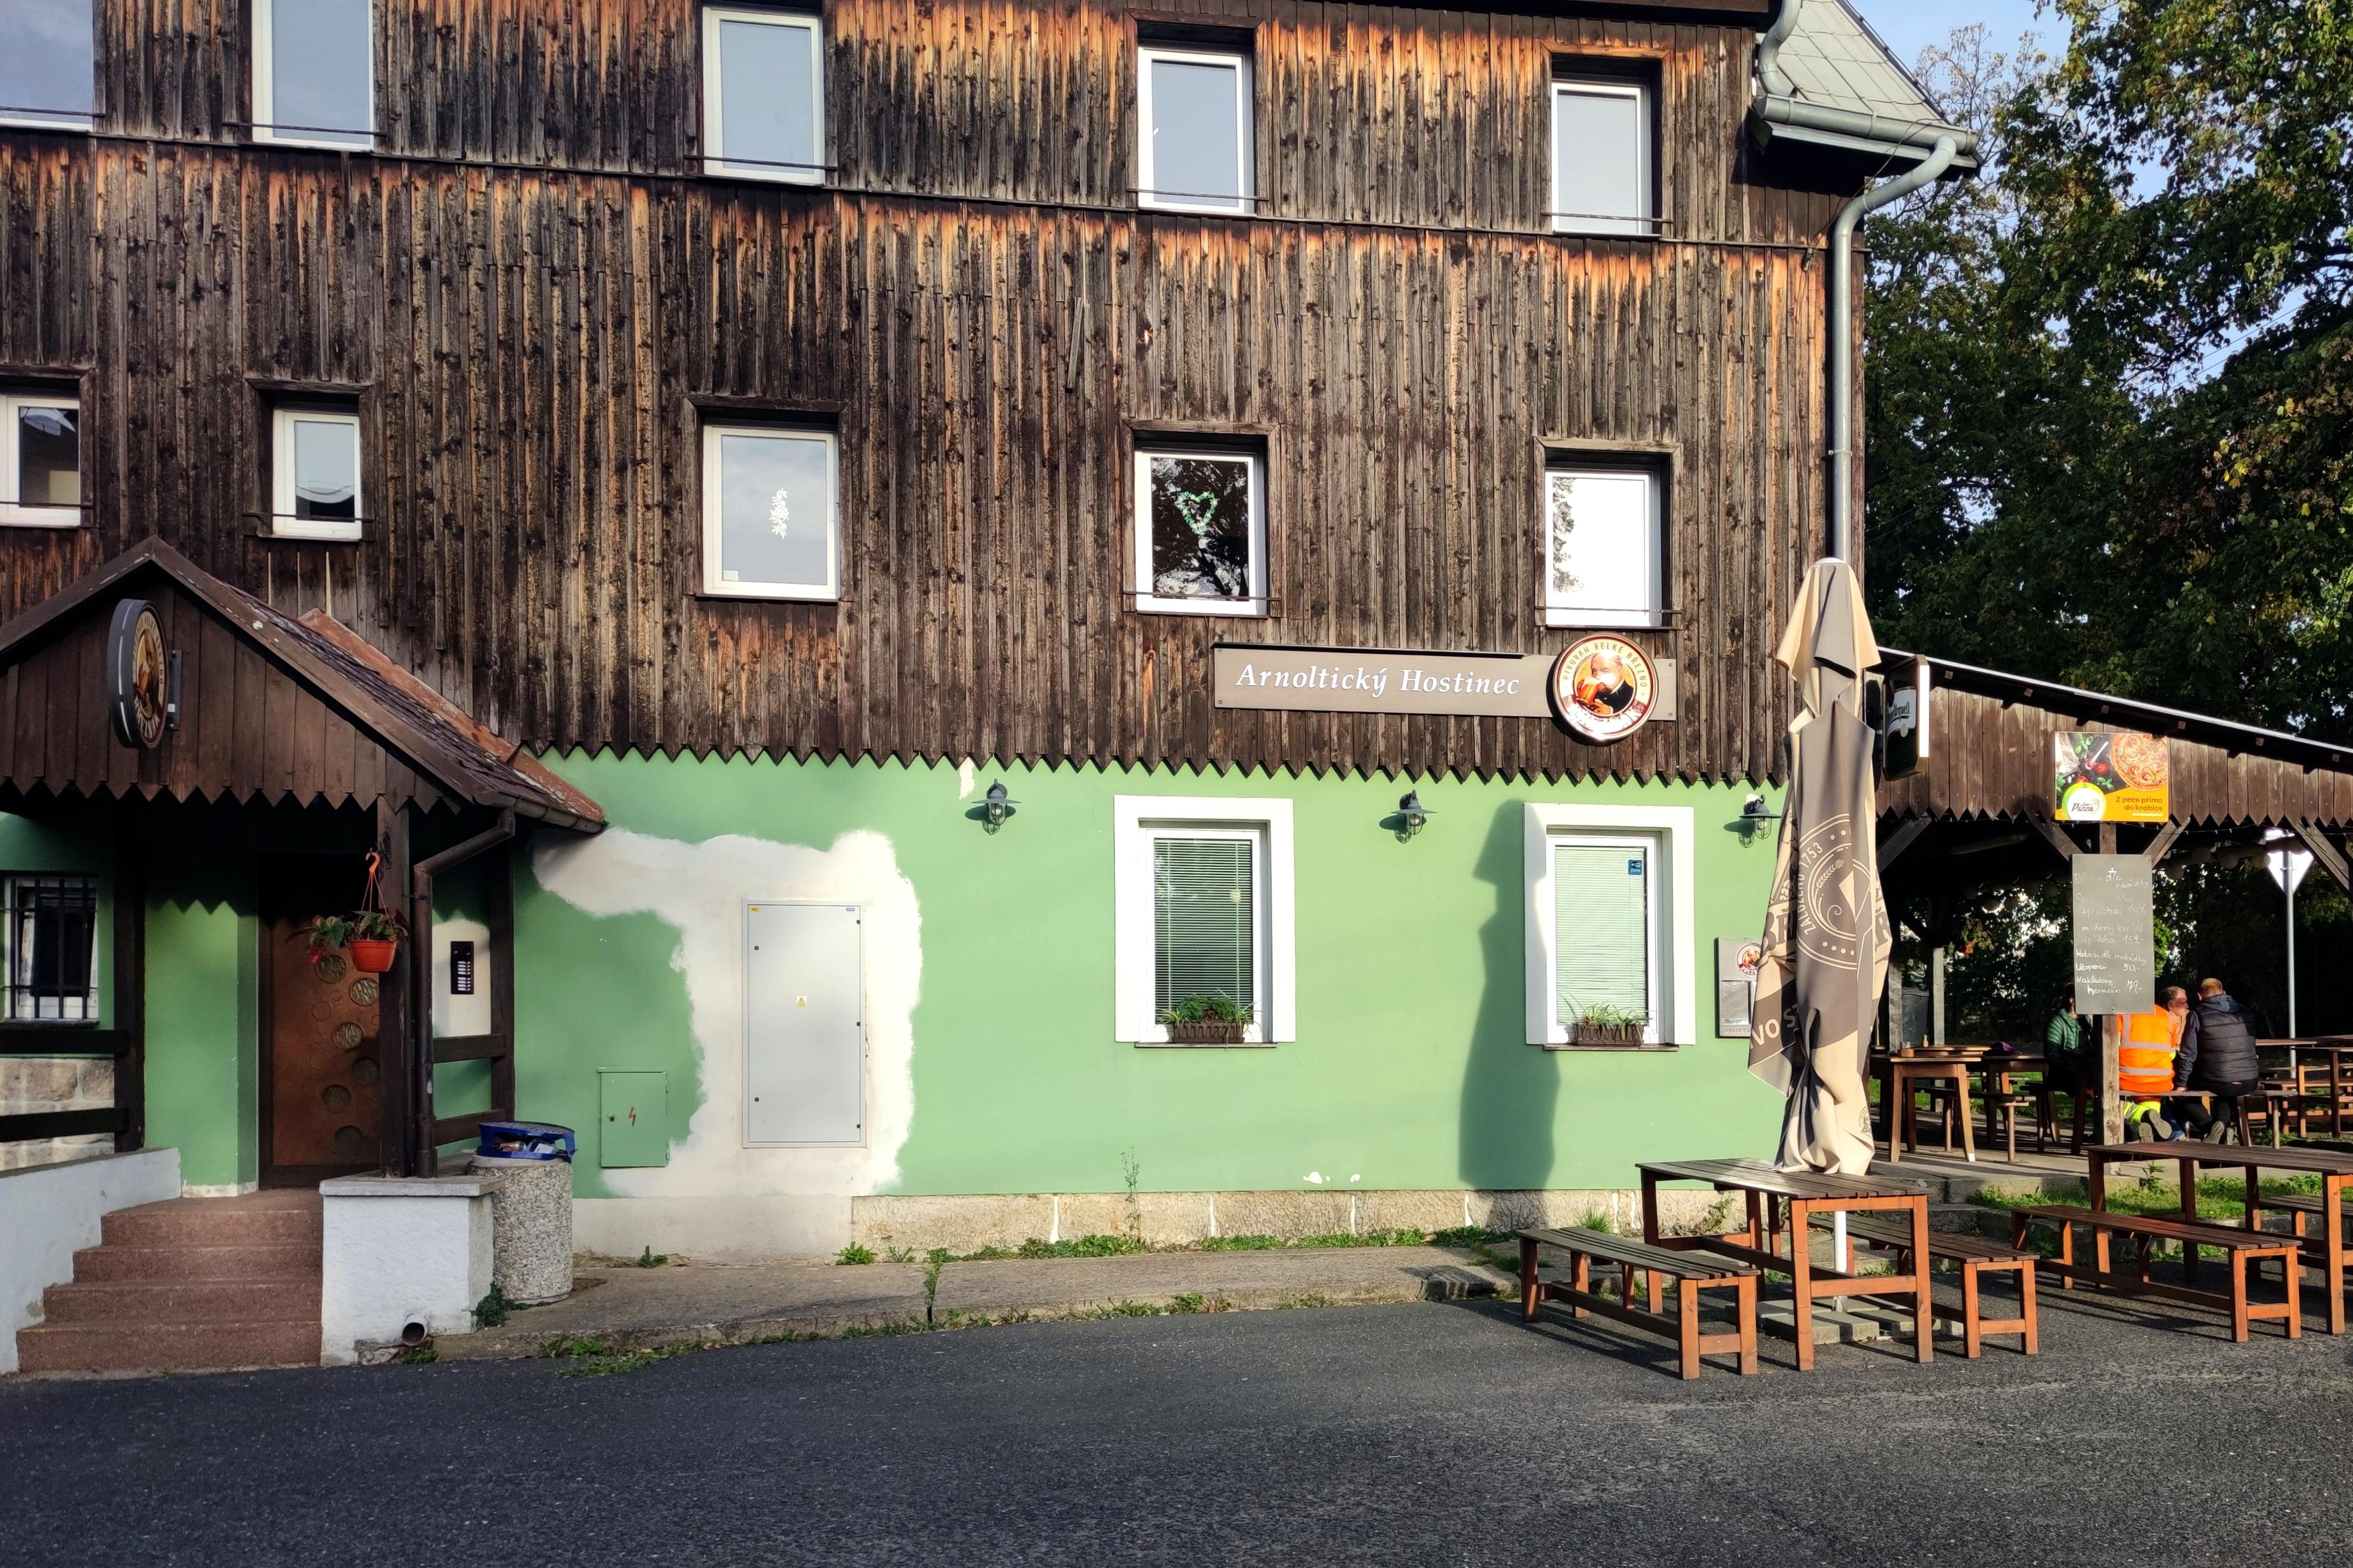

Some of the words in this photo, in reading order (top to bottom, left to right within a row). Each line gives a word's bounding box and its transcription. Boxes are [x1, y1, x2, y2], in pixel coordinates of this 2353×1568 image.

[1562, 645, 1590, 680] PIVOVAR
[1594, 641, 1625, 655] VELKÉ
[1626, 651, 1648, 687] BŘEZNO
[1235, 663, 1389, 698] Arnoltický
[1398, 669, 1521, 695] Hostinec
[2071, 803, 2094, 811] Pizza
[1799, 842, 1823, 869] 1753
